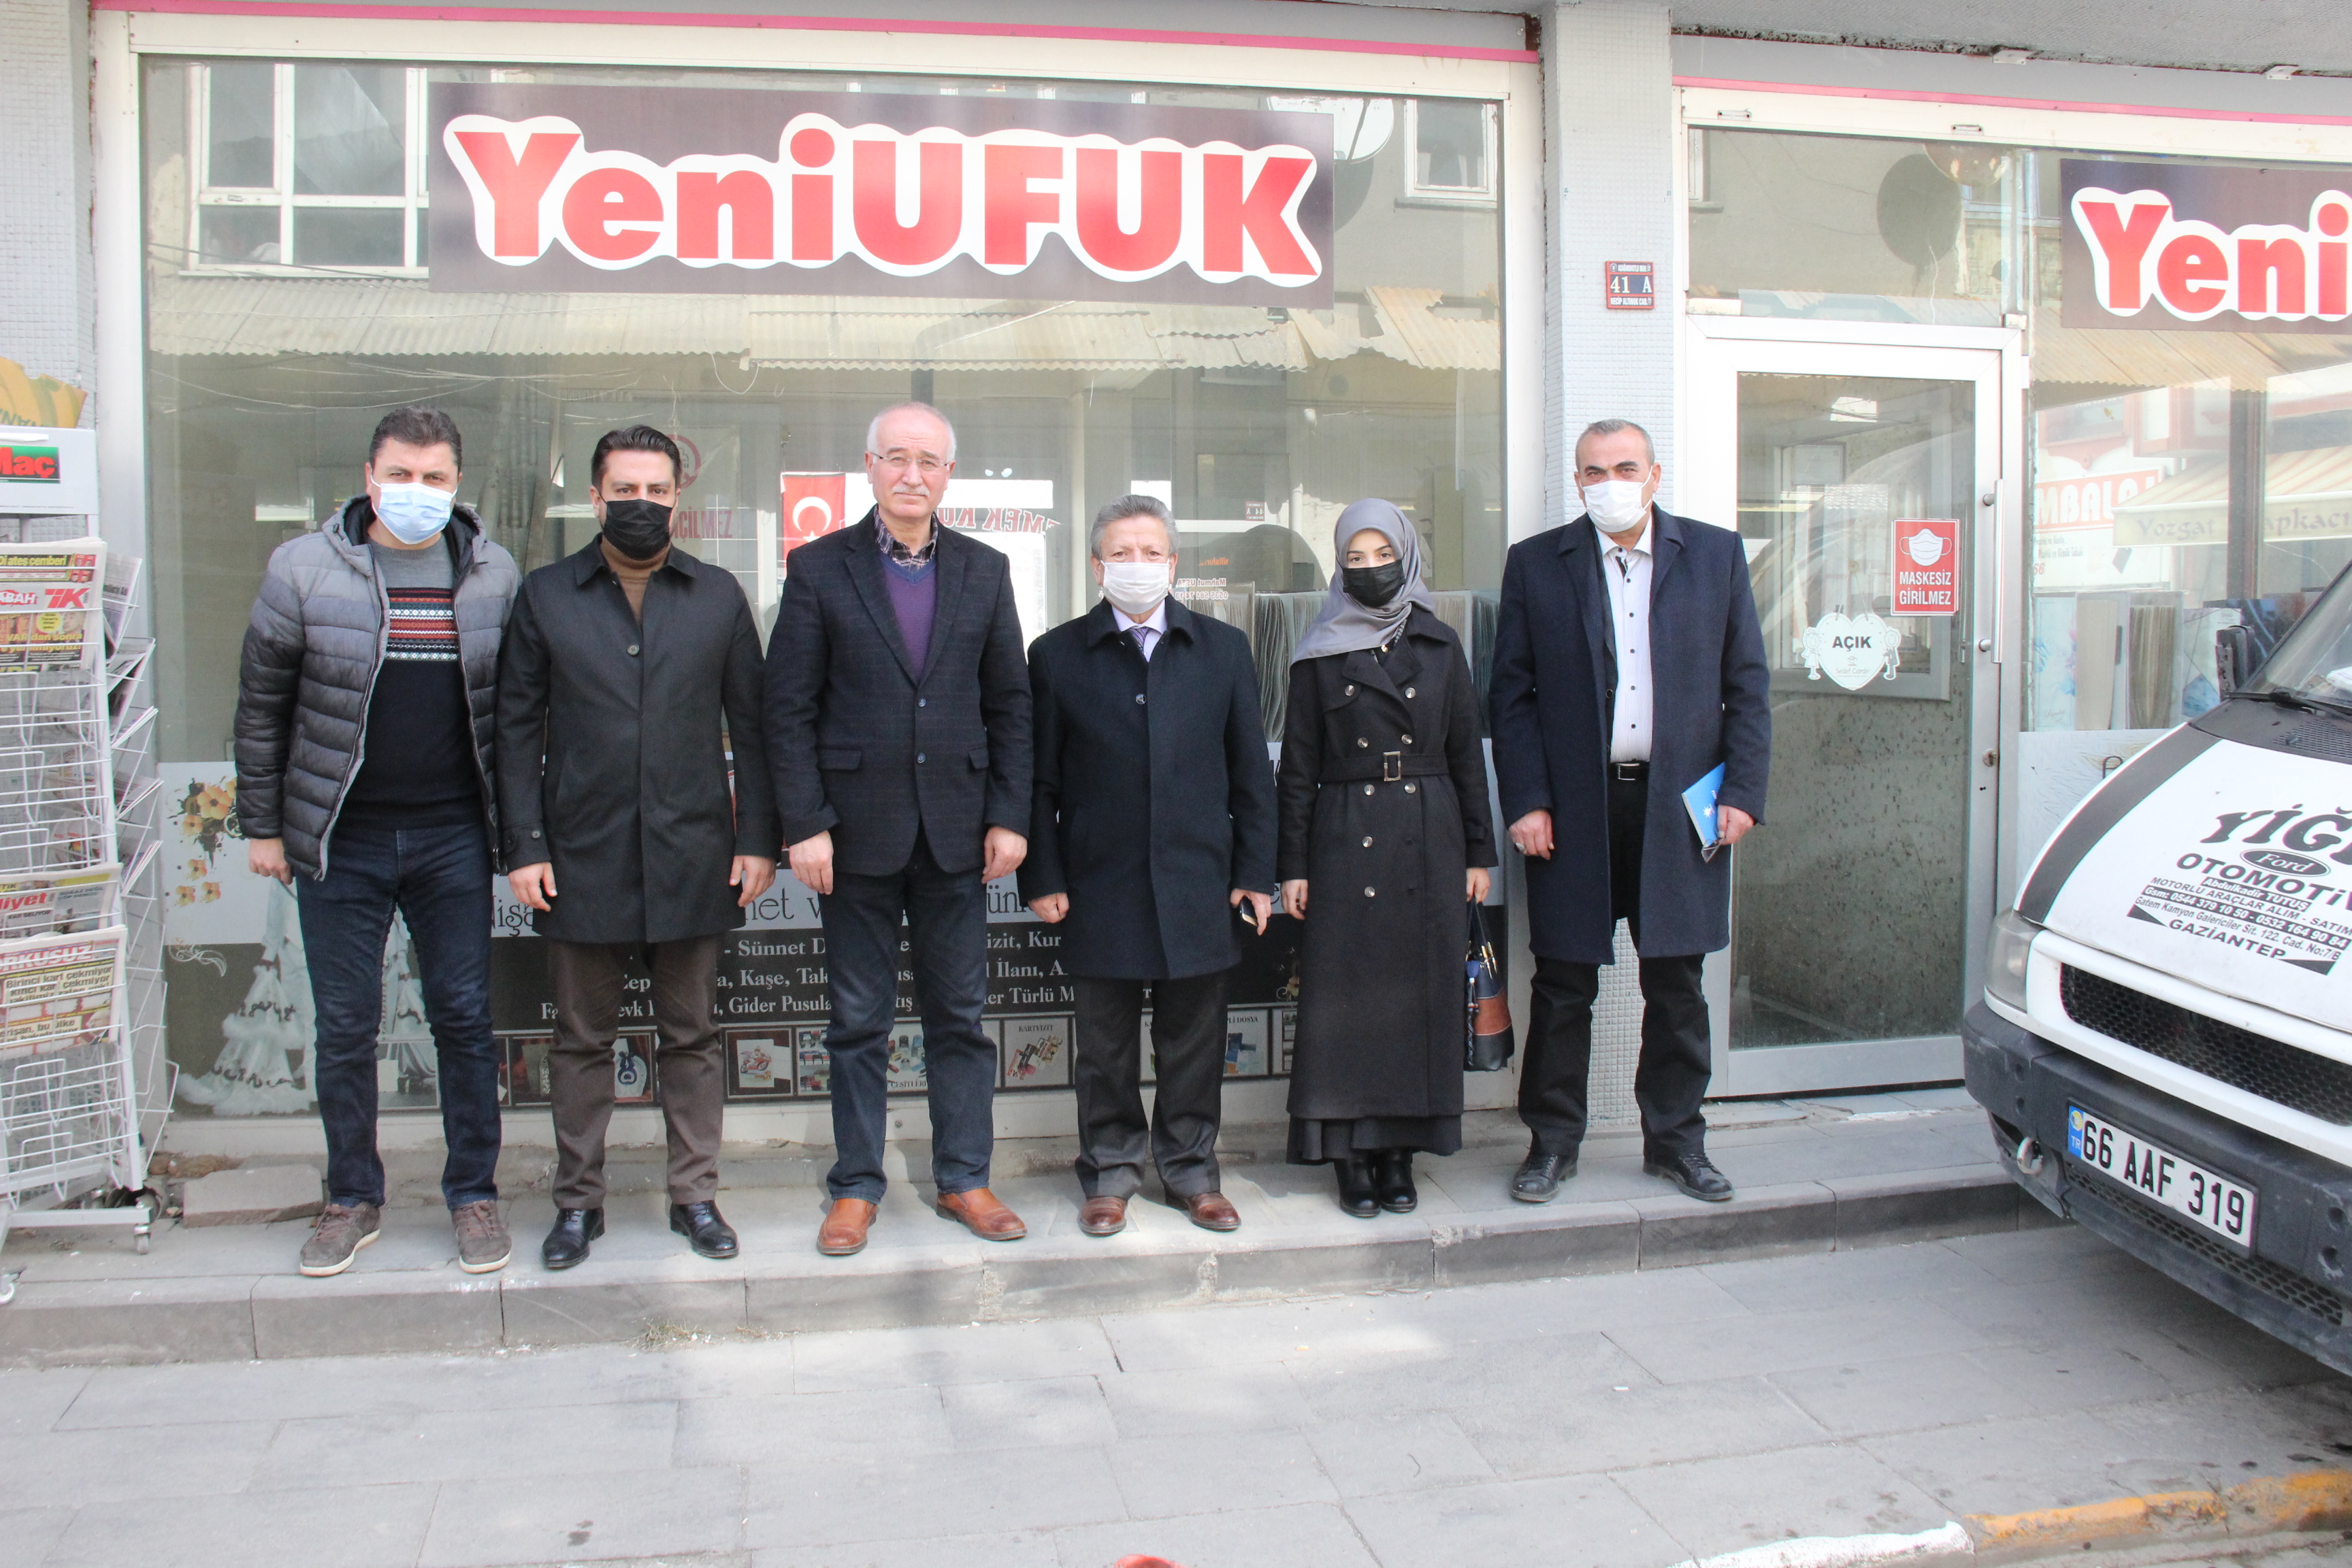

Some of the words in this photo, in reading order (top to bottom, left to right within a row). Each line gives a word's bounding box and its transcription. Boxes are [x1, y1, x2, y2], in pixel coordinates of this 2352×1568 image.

[1610, 276, 1630, 293] 41
[1642, 276, 1652, 293] A
[2136, 518, 2216, 540] Yozgat
[1899, 570, 1952, 585] MASKESİZ
[1899, 588, 1951, 605] GİRİLMEZ
[1832, 636, 1872, 651] AÇIK
[2255, 853, 2315, 872] Ford
[2203, 878, 2266, 898] Abdulkadir
[2151, 877, 2205, 894] MOTORLU
[2206, 890, 2265, 909] ARAÇLAR
[2266, 906, 2300, 919] ALIM
[2135, 896, 2161, 909] Gatem
[2161, 902, 2195, 917] Kamyon
[2196, 911, 2242, 930] Galericiler
[2242, 924, 2257, 935] Sit.
[2260, 929, 2280, 942] 122.
[2282, 936, 2304, 949] Cad.
[2144, 886, 2170, 899] Gsm:
[2170, 892, 2197, 906] 0544
[2196, 898, 2218, 911] 379
[2218, 905, 2234, 916] 10
[2233, 908, 2250, 919] 50
[2255, 915, 2288, 930] 0532
[2287, 923, 2310, 937] 164
[2310, 930, 2329, 942] 90
[2328, 936, 2348, 949] 84
[738, 939, 806, 956] Sünnet
[2169, 919, 2286, 958] GAZİANTEP
[996, 958, 1044, 978] İlanı,
[740, 969, 790, 990] Kaşe,
[729, 996, 776, 1013] Gider
[1009, 987, 1055, 1004] Türlü
[2070, 1134, 2081, 1151] TR
[2082, 1120, 2114, 1170] 66
[2123, 1141, 2175, 1198] AAF
[2187, 1171, 2245, 1235] 319
